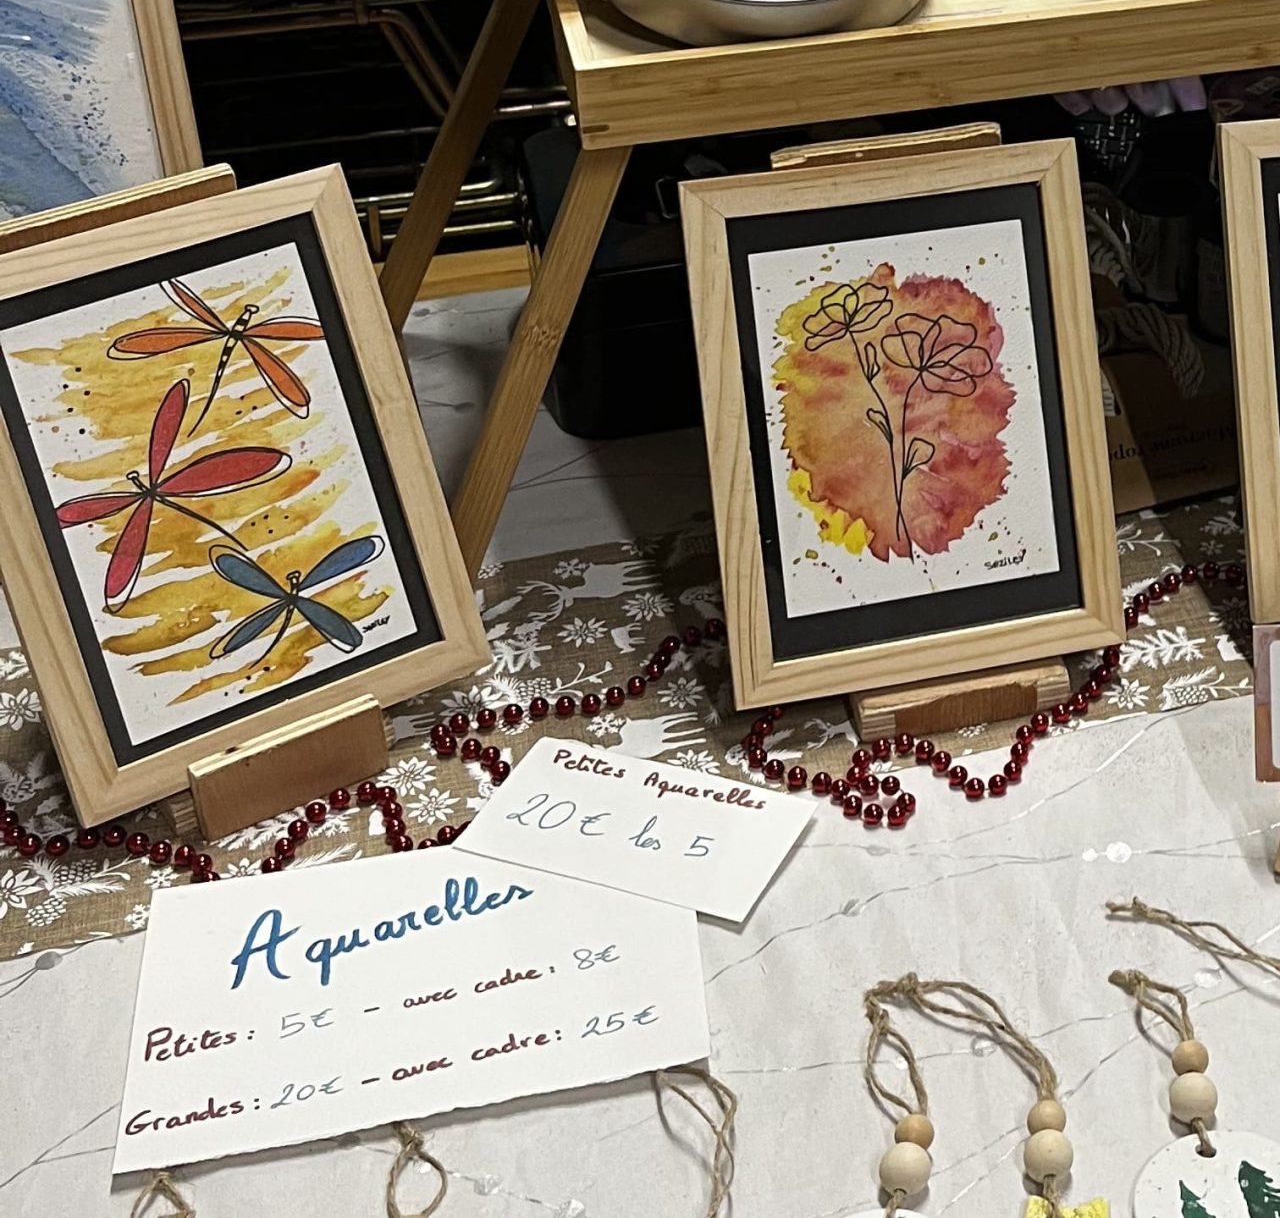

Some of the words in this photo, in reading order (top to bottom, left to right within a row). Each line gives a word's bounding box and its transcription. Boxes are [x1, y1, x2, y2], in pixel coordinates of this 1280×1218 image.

[552, 748, 627, 780] Petites
[643, 770, 767, 811] Aquarelles
[627, 814, 663, 852] les
[683, 835, 715, 858] 5
[229, 875, 536, 992] Aquarelles
[278, 1007, 337, 1041] 5€
[401, 985, 459, 1011] avec
[571, 942, 621, 973] 8€
[268, 1075, 345, 1112] 20€
[390, 1054, 453, 1084] avec
[580, 1003, 661, 1040] 25€
